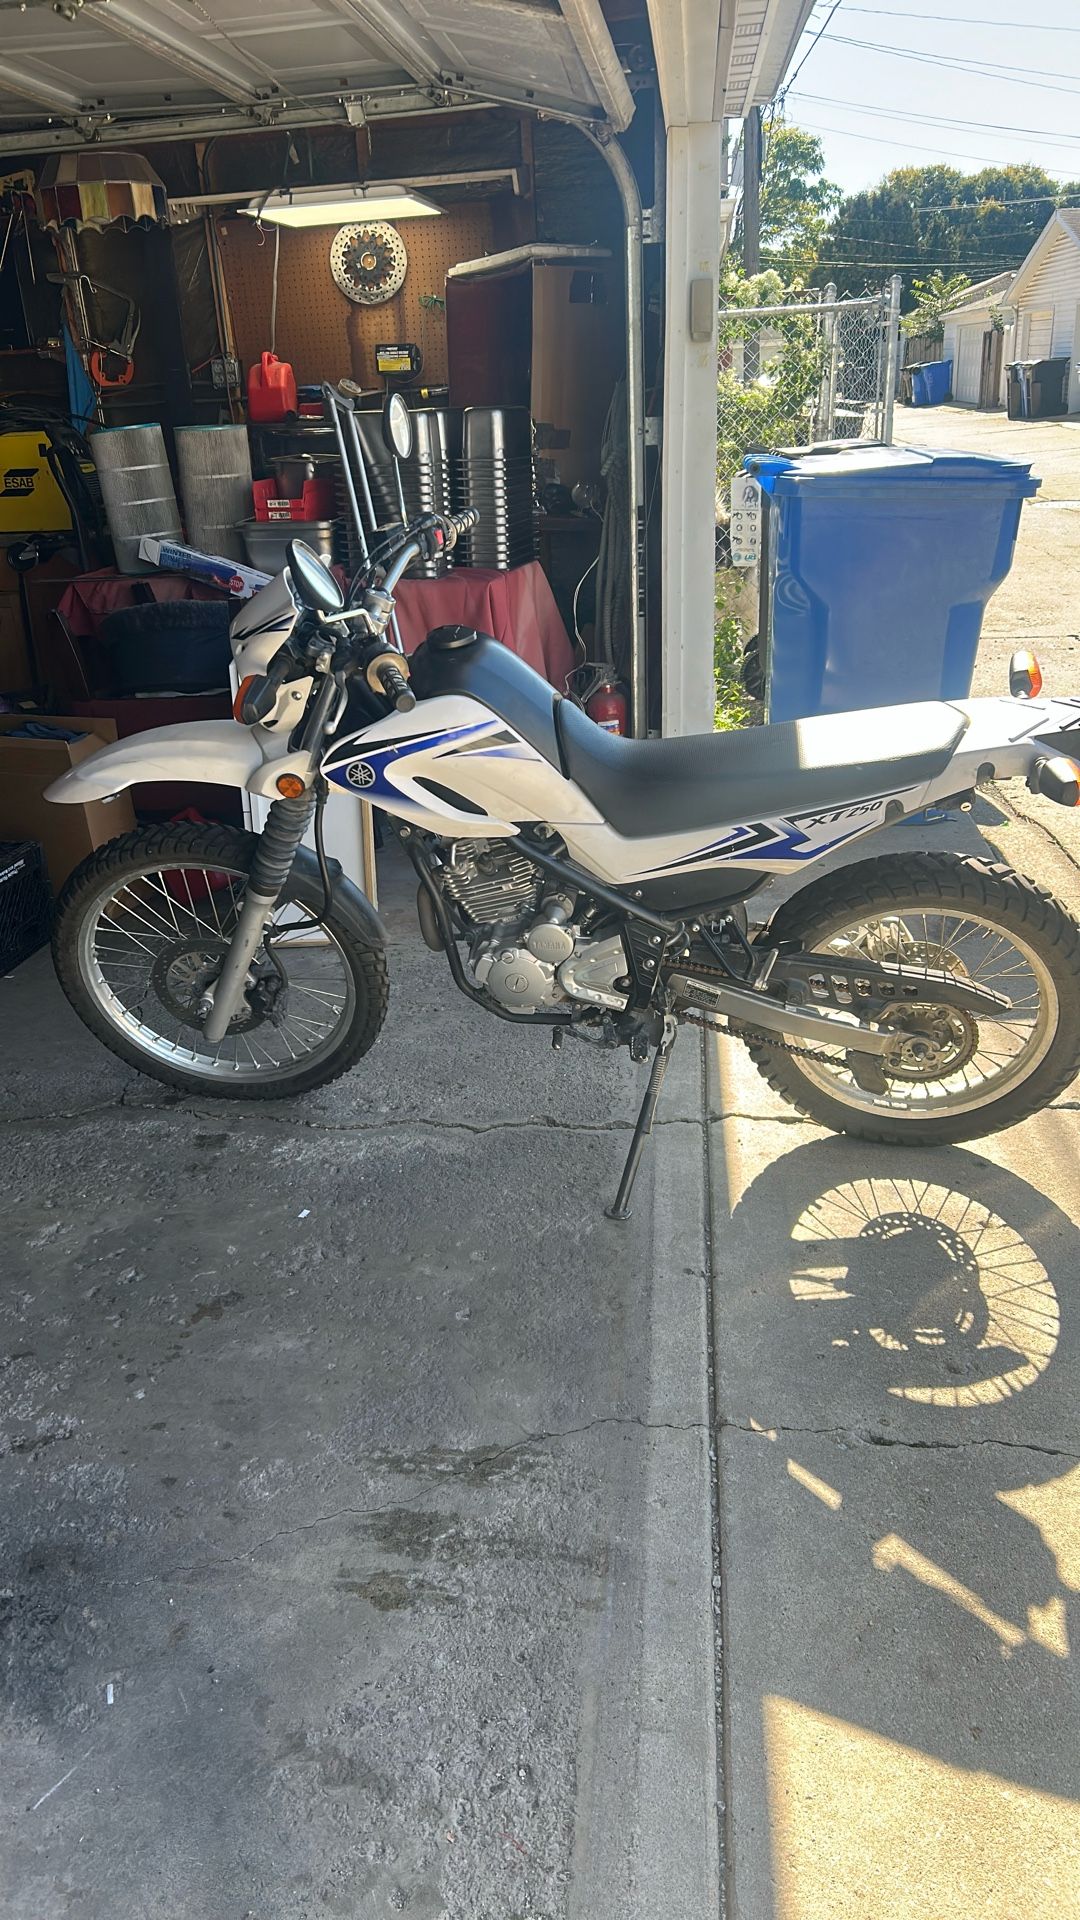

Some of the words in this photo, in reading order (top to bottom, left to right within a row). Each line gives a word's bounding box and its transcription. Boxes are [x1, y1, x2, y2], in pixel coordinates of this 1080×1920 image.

[4, 477, 34, 488] ESAB
[161, 546, 192, 559] WINTER
[229, 579, 243, 588] STOP
[803, 801, 883, 829] XT250
[533, 941, 566, 950] YAMAHA
